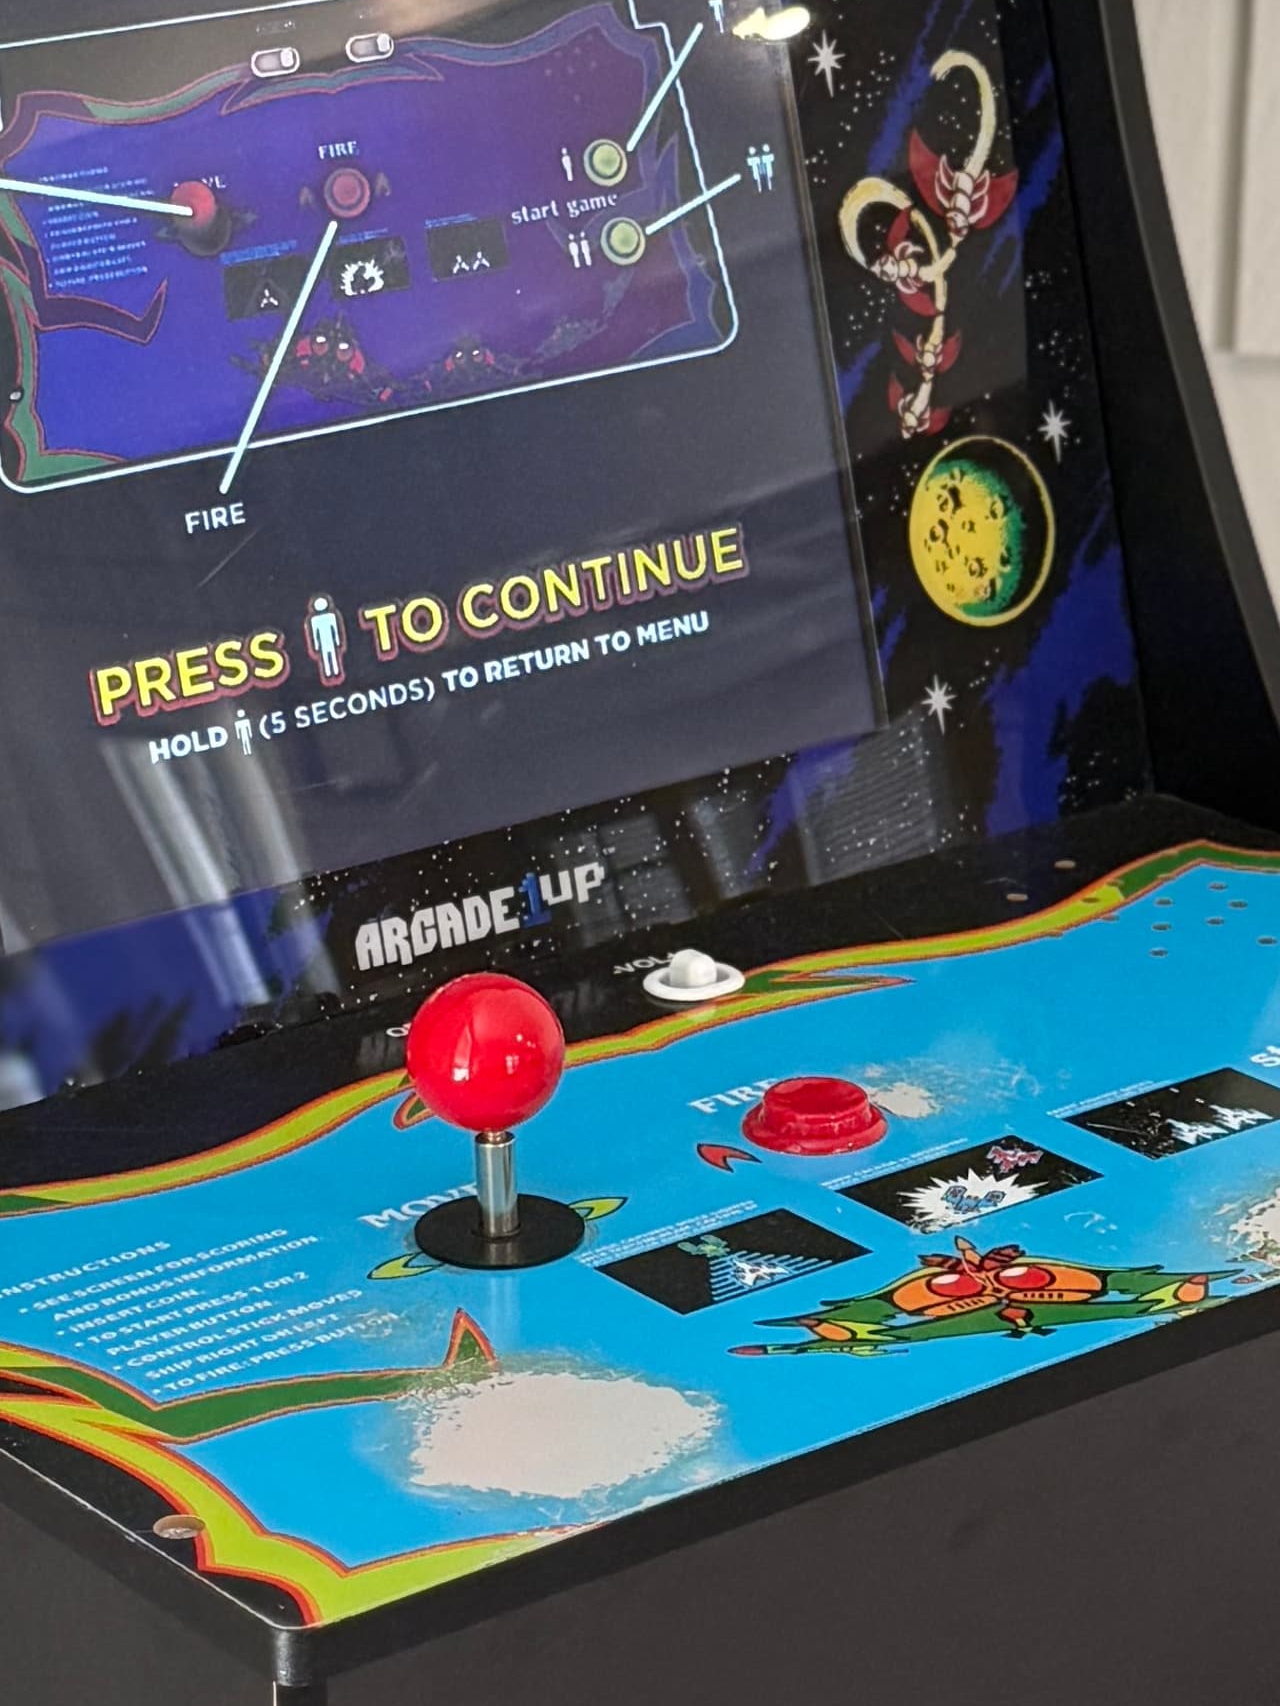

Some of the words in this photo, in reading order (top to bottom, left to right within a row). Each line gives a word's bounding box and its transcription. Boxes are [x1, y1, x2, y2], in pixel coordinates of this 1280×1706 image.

[511, 200, 559, 225] start
[566, 193, 618, 218] game
[184, 501, 246, 535] FIRE
[92, 629, 288, 723] PRESS
[362, 597, 449, 659] TO
[458, 526, 746, 636] CONTINUE
[148, 726, 230, 765] HOLD
[258, 711, 287, 742] (5
[294, 678, 436, 729] SECONDS)
[441, 667, 480, 695] TO
[483, 642, 590, 684] RETURN
[594, 629, 631, 659] TO
[635, 609, 711, 646] MENU
[33, 1294, 73, 1311] SEE
[72, 1269, 154, 1298] SCREEN
[154, 1256, 197, 1273] FOR
[196, 1228, 288, 1261] SCORING
[54, 1302, 99, 1321] AND
[100, 1280, 175, 1306] BONUS
[173, 1235, 319, 1283] INFORMATION
[69, 1305, 143, 1333] INSERT
[88, 1331, 117, 1343] TO
[118, 1311, 182, 1334] START
[183, 1290, 249, 1314] PRESS
[248, 1285, 263, 1294] 1
[263, 1276, 294, 1290] OR
[293, 1271, 309, 1280] 2
[127, 1332, 225, 1368] CONTROL
[224, 1314, 286, 1337] STICK
[286, 1289, 363, 1317] MOVES
[106, 1326, 189, 1356] PLAYER
[145, 1359, 193, 1380] SHIP
[195, 1338, 260, 1364] RIGHT
[165, 1377, 195, 1392] TO
[249, 1339, 316, 1365] PRESS
